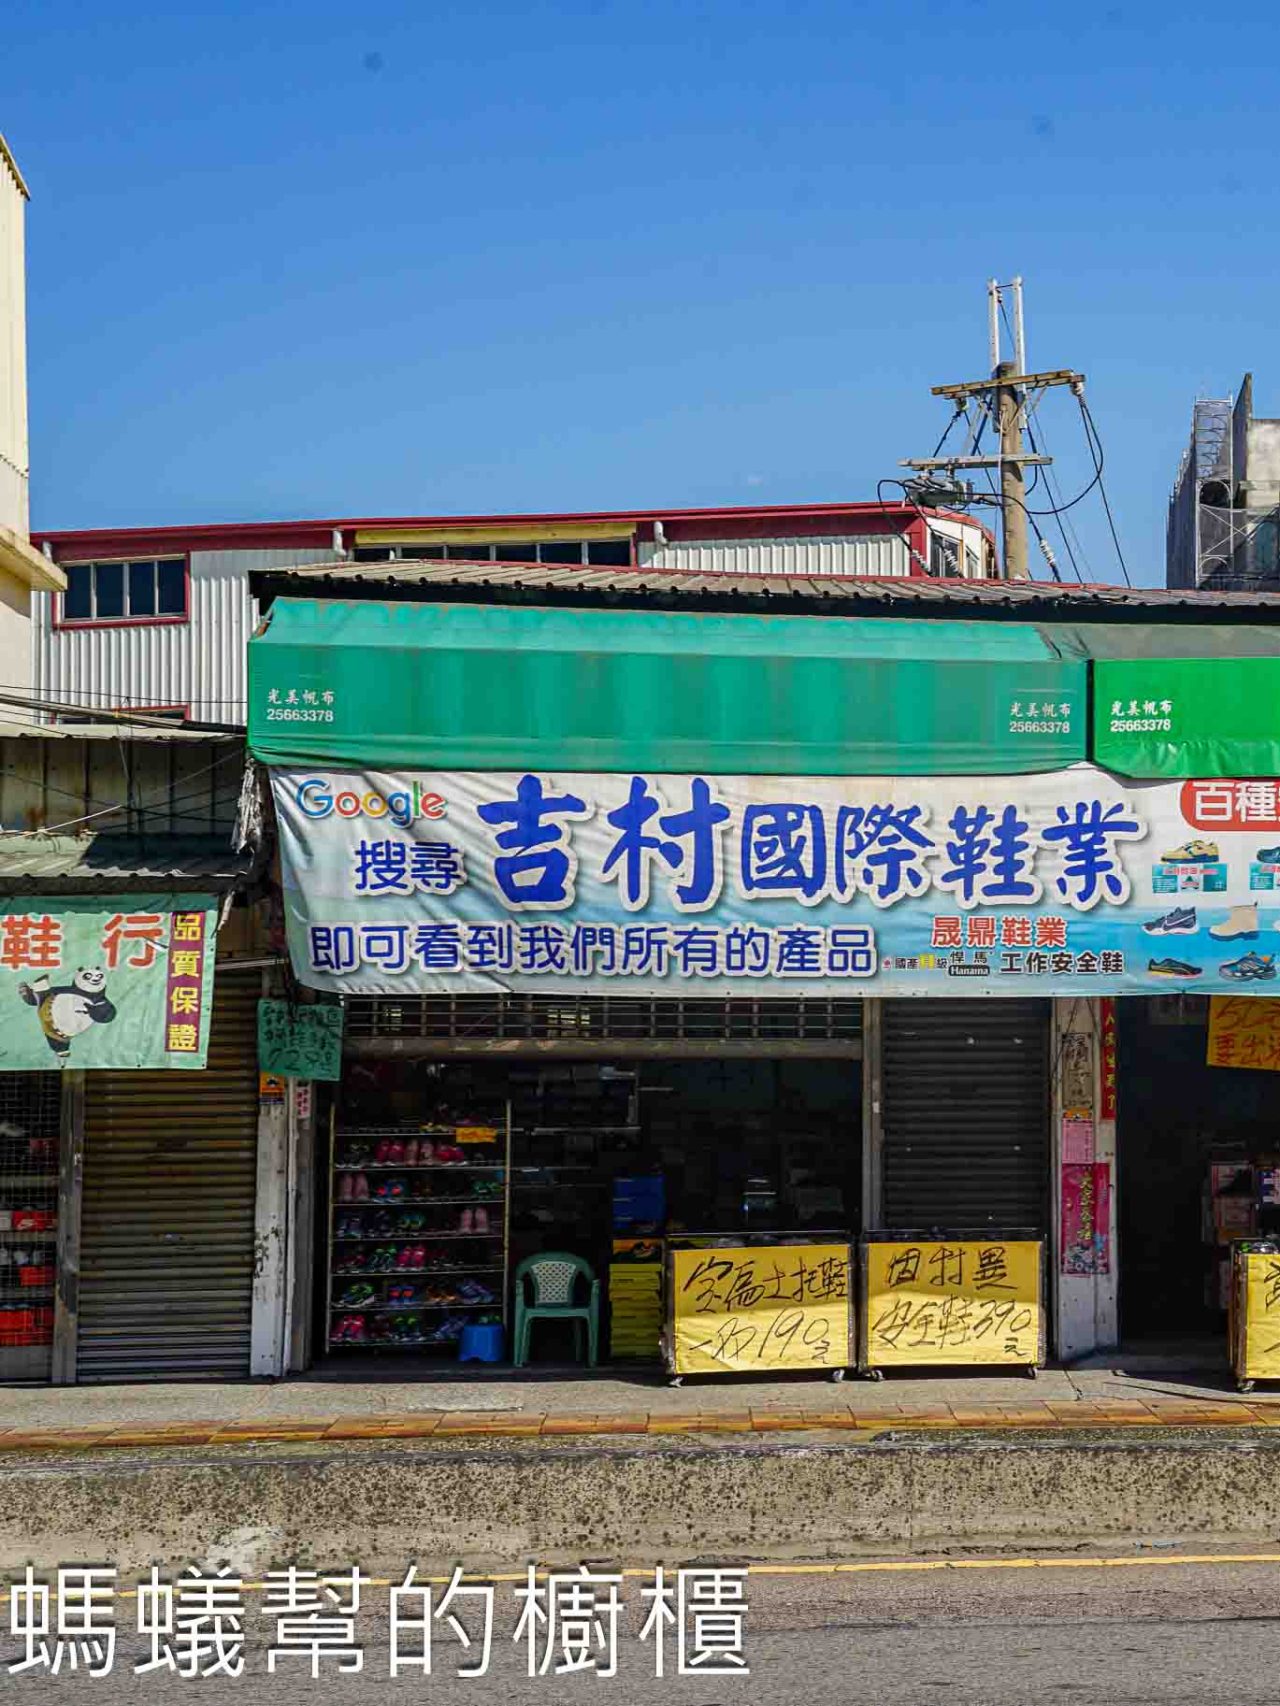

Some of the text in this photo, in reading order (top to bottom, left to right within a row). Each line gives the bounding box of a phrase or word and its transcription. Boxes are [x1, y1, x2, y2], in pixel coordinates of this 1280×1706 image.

[266, 709, 334, 723] 25663378
[1009, 721, 1070, 733] 25663378
[1110, 718, 1171, 732] 25663378
[297, 778, 447, 827] Google
[477, 774, 1139, 904] 吉村國際鞋業
[355, 841, 463, 892] 搜尋
[311, 925, 872, 973] 即可看到我們所有的產品
[932, 917, 1066, 946] 晟鼎鞋業
[1001, 952, 1124, 974] 工作安全鞋
[168, 914, 201, 1051] 品質保證
